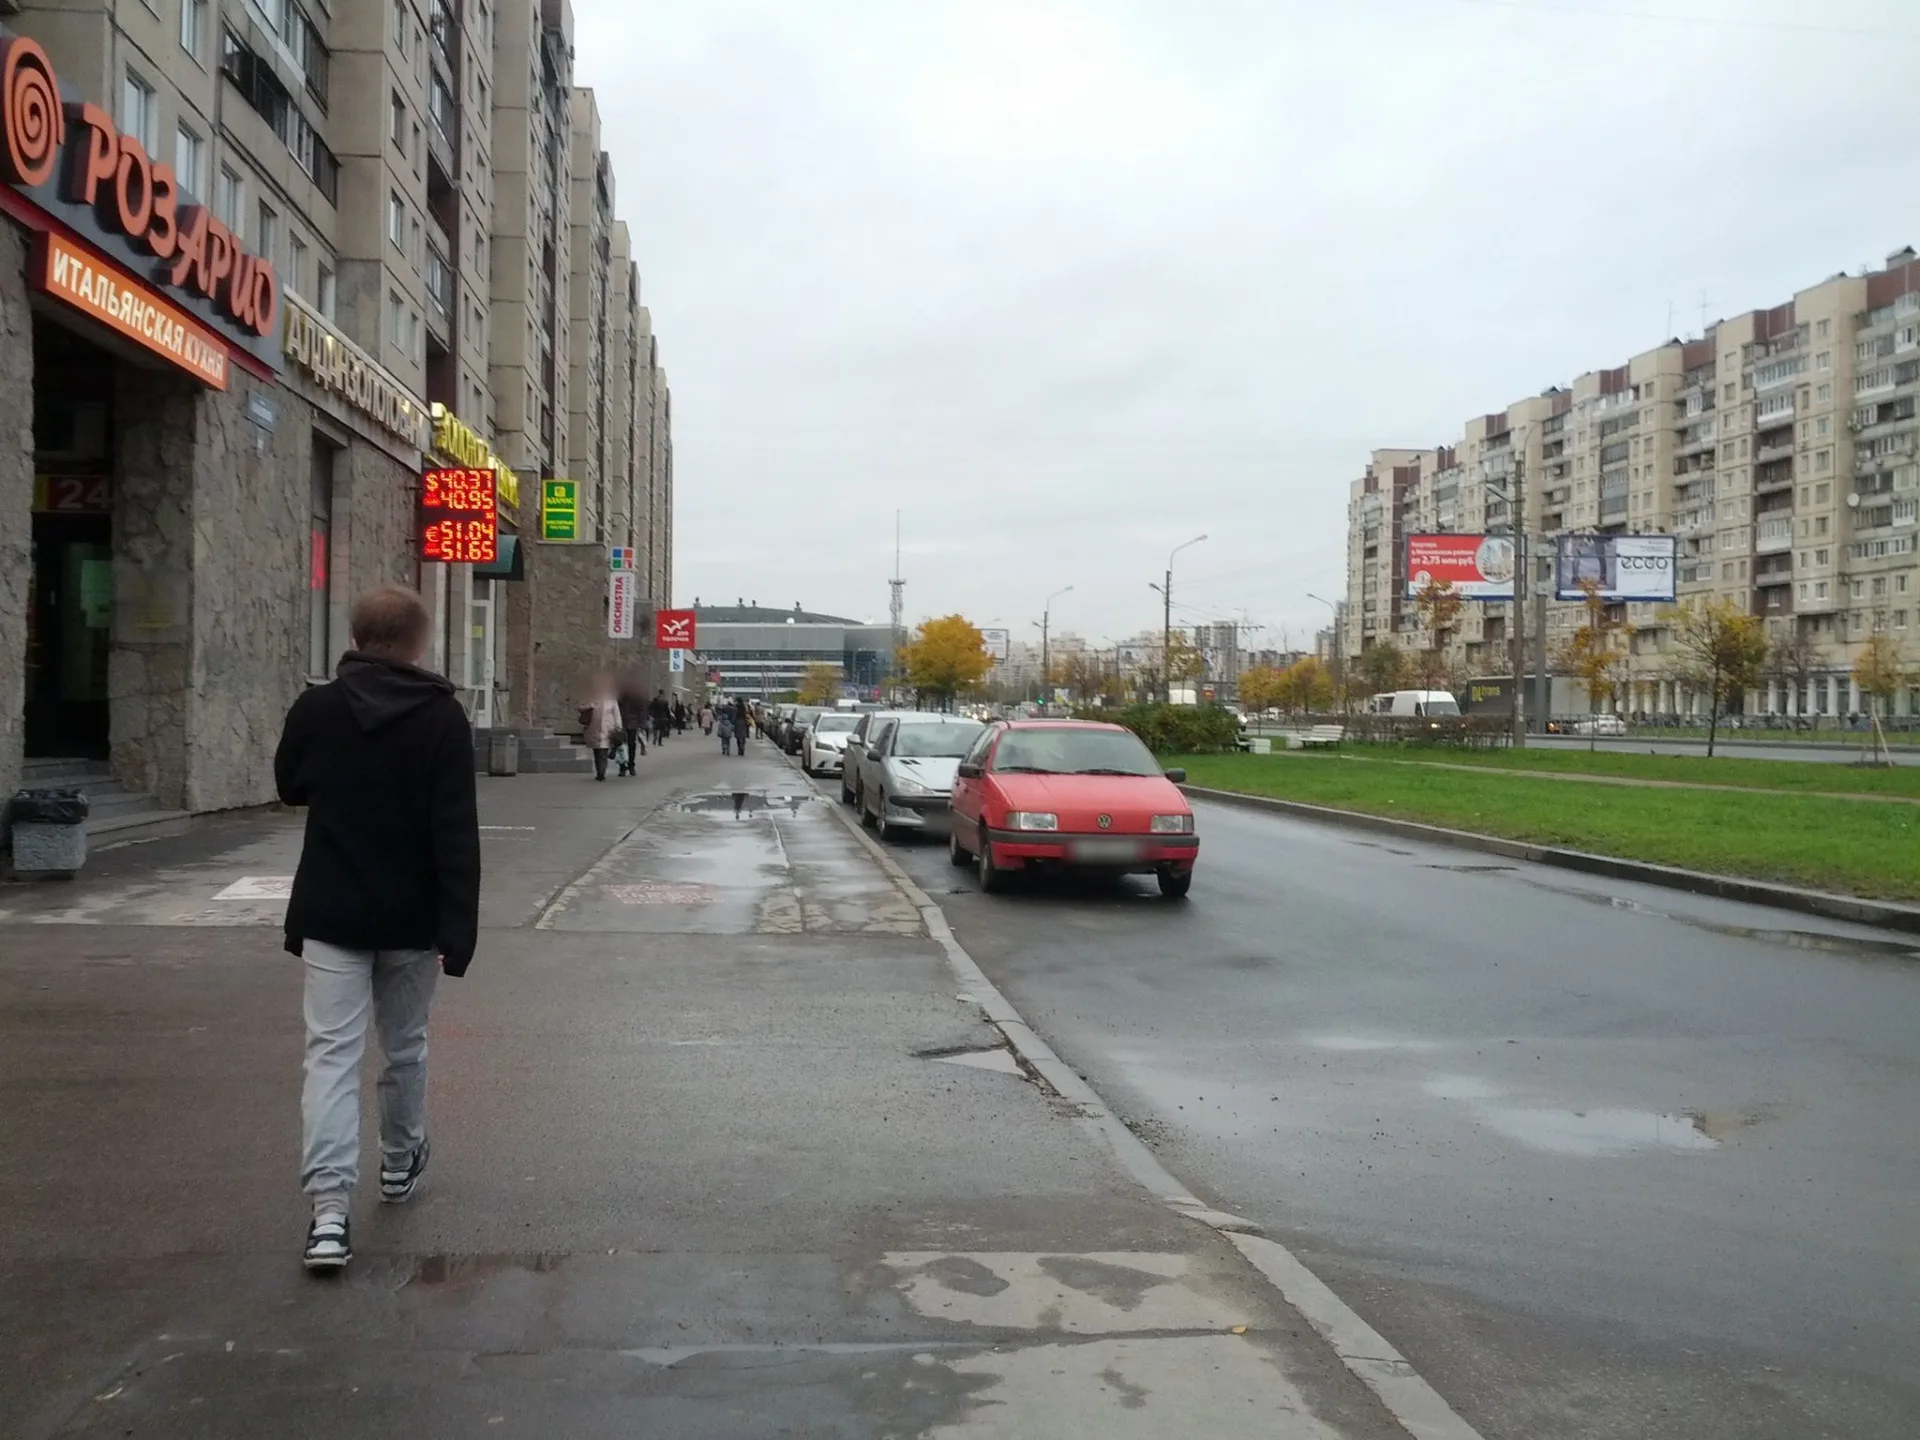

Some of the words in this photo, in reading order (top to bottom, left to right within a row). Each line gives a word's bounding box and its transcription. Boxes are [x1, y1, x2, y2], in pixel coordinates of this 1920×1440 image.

[82, 102, 276, 337] РОЗАРИО
[52, 248, 185, 352] ИТАЛЬЯНСКАЯ
[185, 339, 224, 381] КУХНЯ
[441, 541, 494, 560] 51.65
[613, 576, 624, 633] ORCHESTRA
